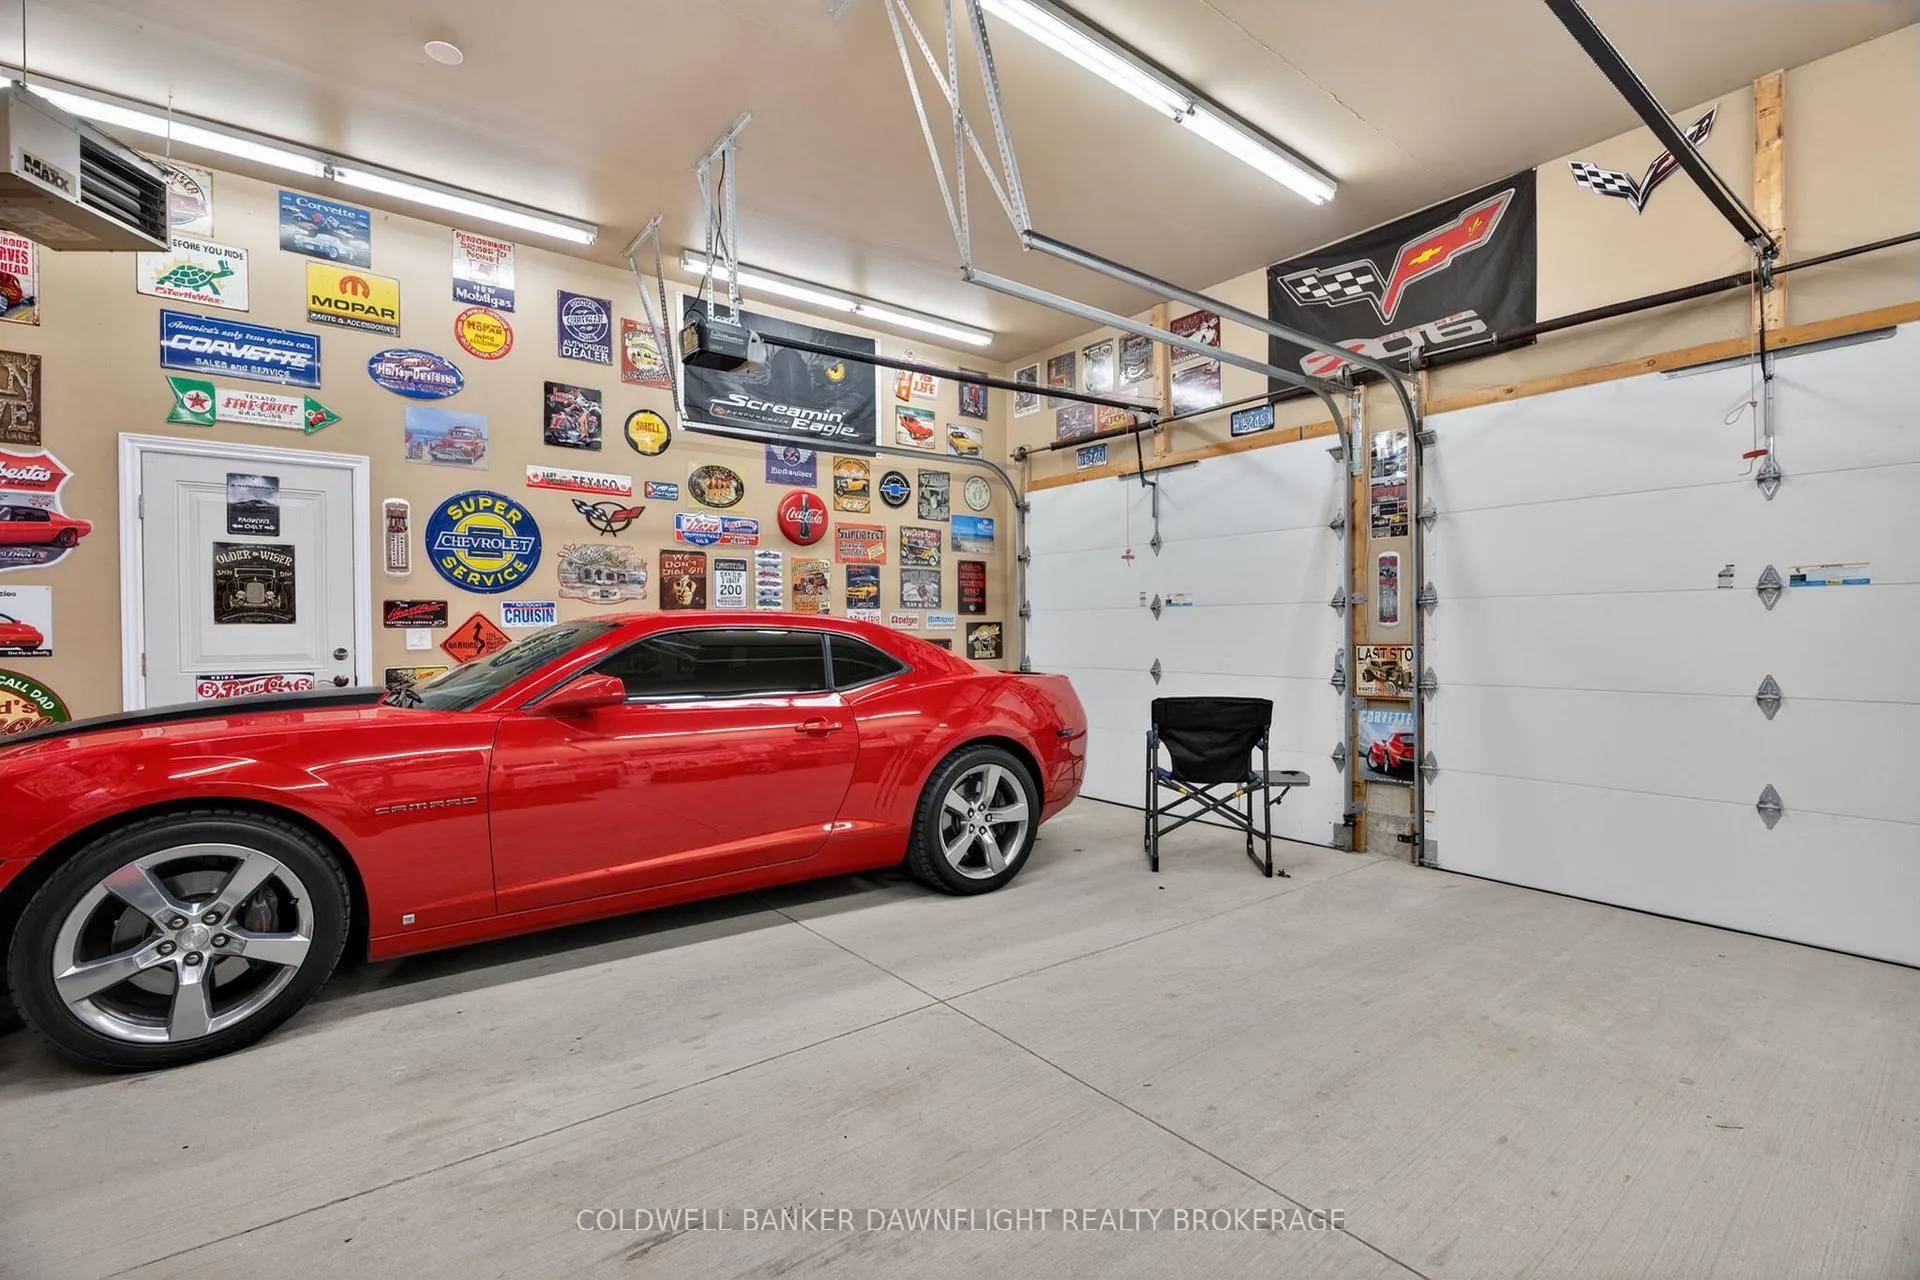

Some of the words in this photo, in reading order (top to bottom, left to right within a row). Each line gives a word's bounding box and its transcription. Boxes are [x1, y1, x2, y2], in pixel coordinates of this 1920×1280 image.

[296, 197, 356, 218] Corvette
[172, 238, 200, 251] EFORE
[203, 245, 222, 256] YOU
[224, 250, 244, 261] RIDE
[0, 262, 29, 276] HEAD
[311, 295, 395, 319] MOPAR
[455, 287, 512, 308] Mobilgas
[168, 320, 219, 335] America's
[222, 331, 243, 340] only
[168, 334, 312, 367] CORVETTE
[563, 346, 609, 364] DEALER
[195, 358, 227, 370] SALES
[230, 363, 247, 372] and
[250, 365, 290, 377] SERVICE
[376, 363, 456, 384] Harley-Davidson
[710, 393, 846, 423] Screamin'
[791, 417, 860, 436] Eagle
[572, 475, 618, 490] TEXACO
[447, 497, 523, 524] SUPER
[441, 535, 529, 551] CHEVROLET
[216, 549, 252, 564] OLDER
[260, 550, 293, 566] WISER
[442, 556, 528, 587] SERVICE
[720, 585, 742, 595] 200
[505, 608, 554, 623] CRUISIN
[1358, 647, 1387, 660] LAST
[1390, 648, 1413, 661] STO
[30, 689, 54, 709] DAD
[1360, 710, 1413, 725] CORVETTE
[375, 797, 477, 814] CAMARO
